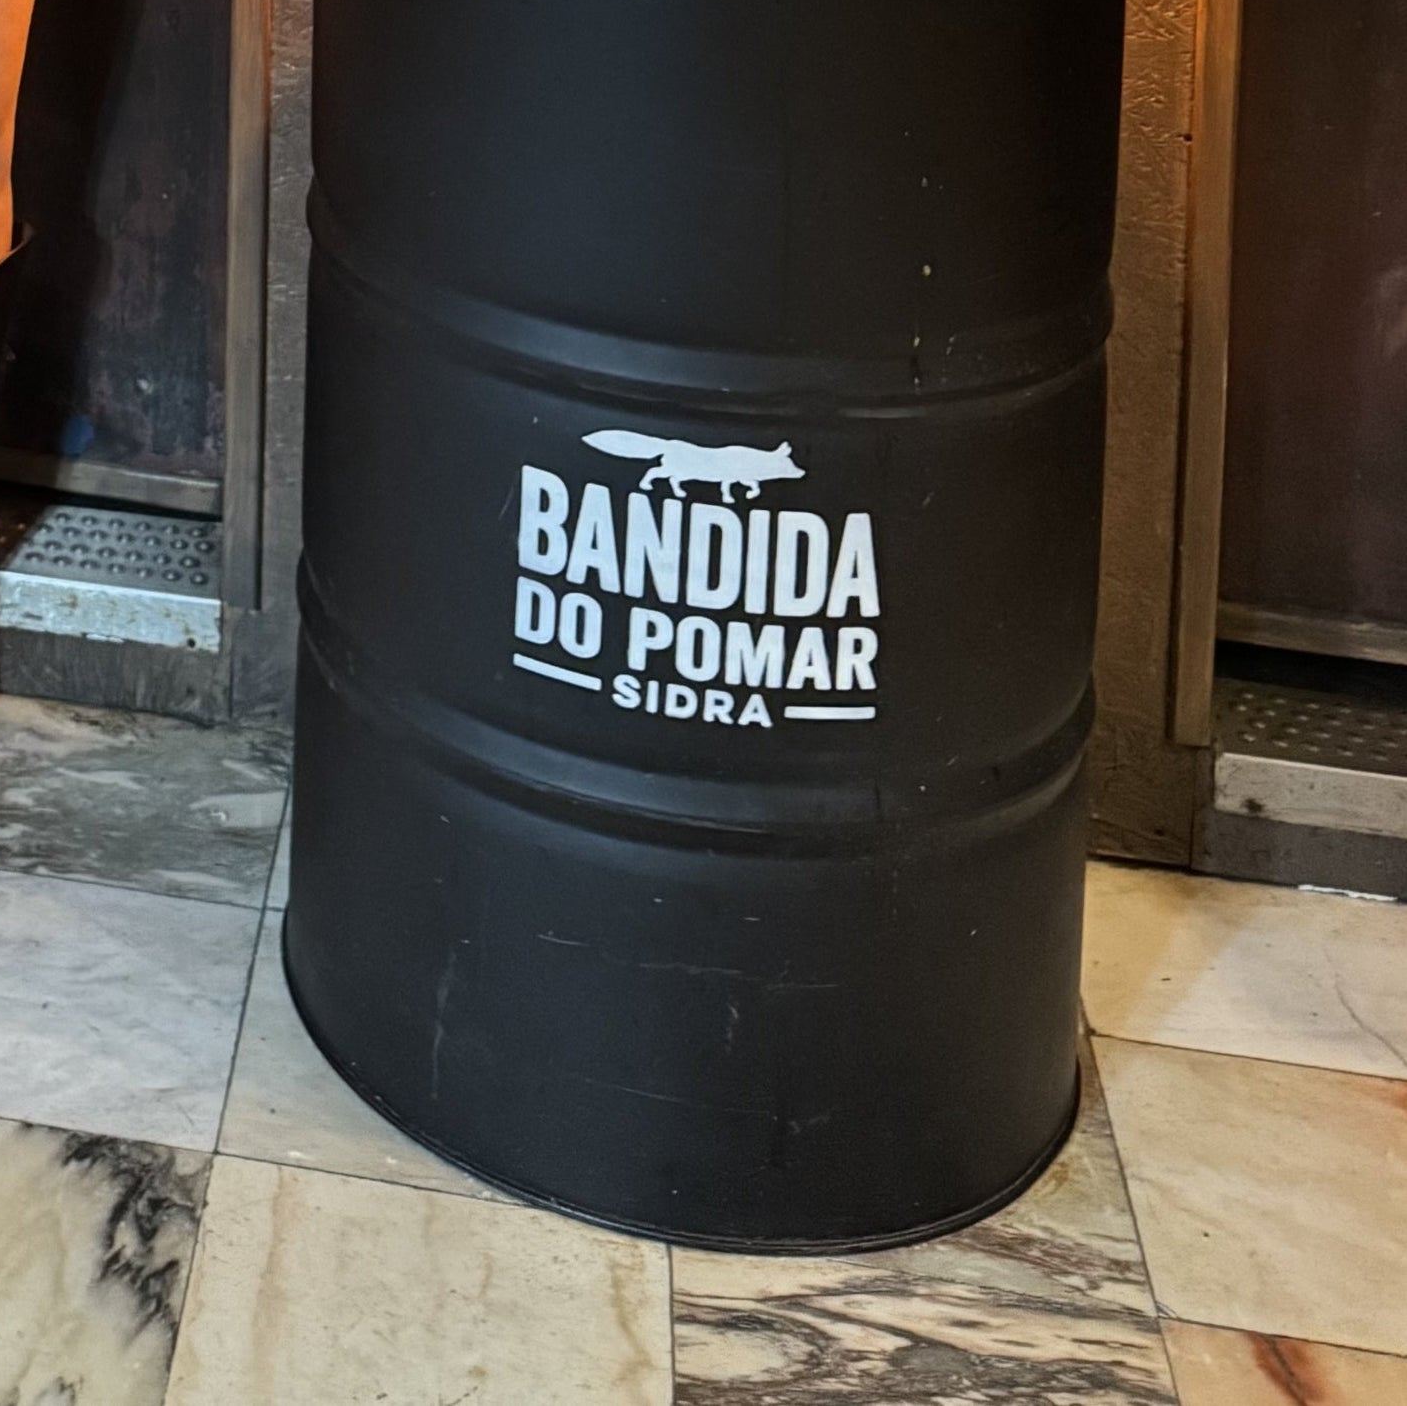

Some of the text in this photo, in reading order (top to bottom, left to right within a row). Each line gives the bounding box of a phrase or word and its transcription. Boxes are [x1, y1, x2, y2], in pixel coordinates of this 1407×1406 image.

[518, 464, 881, 618] BANDIDA
[514, 575, 879, 690] DO POMAR
[611, 674, 773, 728] SIDRA
